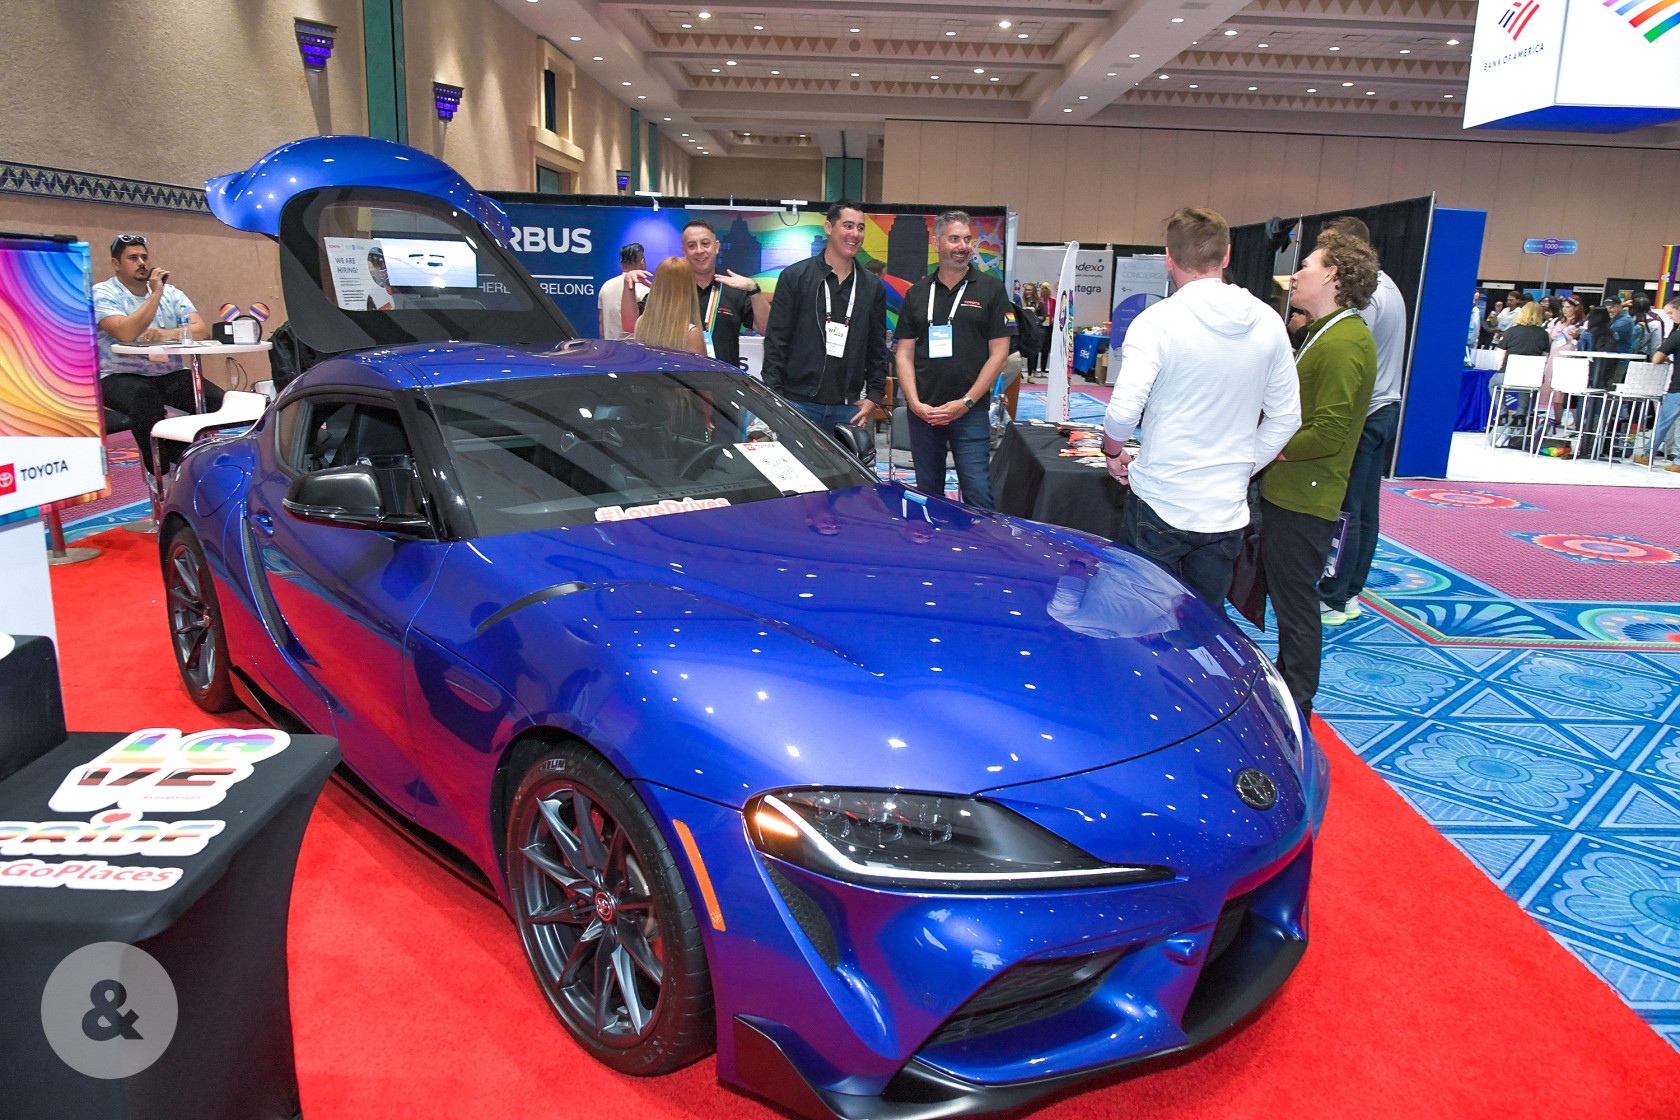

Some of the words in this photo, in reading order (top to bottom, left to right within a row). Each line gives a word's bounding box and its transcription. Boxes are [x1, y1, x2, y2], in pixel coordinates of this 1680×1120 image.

[1483, 58, 1502, 71] BANK
[1503, 54, 1512, 65] OF
[1513, 42, 1545, 60] AMERICA
[337, 266, 359, 274] HIRING!
[1075, 261, 1105, 272] dexo
[540, 283, 595, 295] BELONG
[20, 460, 69, 481] TOYOTA
[599, 499, 728, 520] #LoveDrives
[0, 862, 173, 882] GoPlaces
